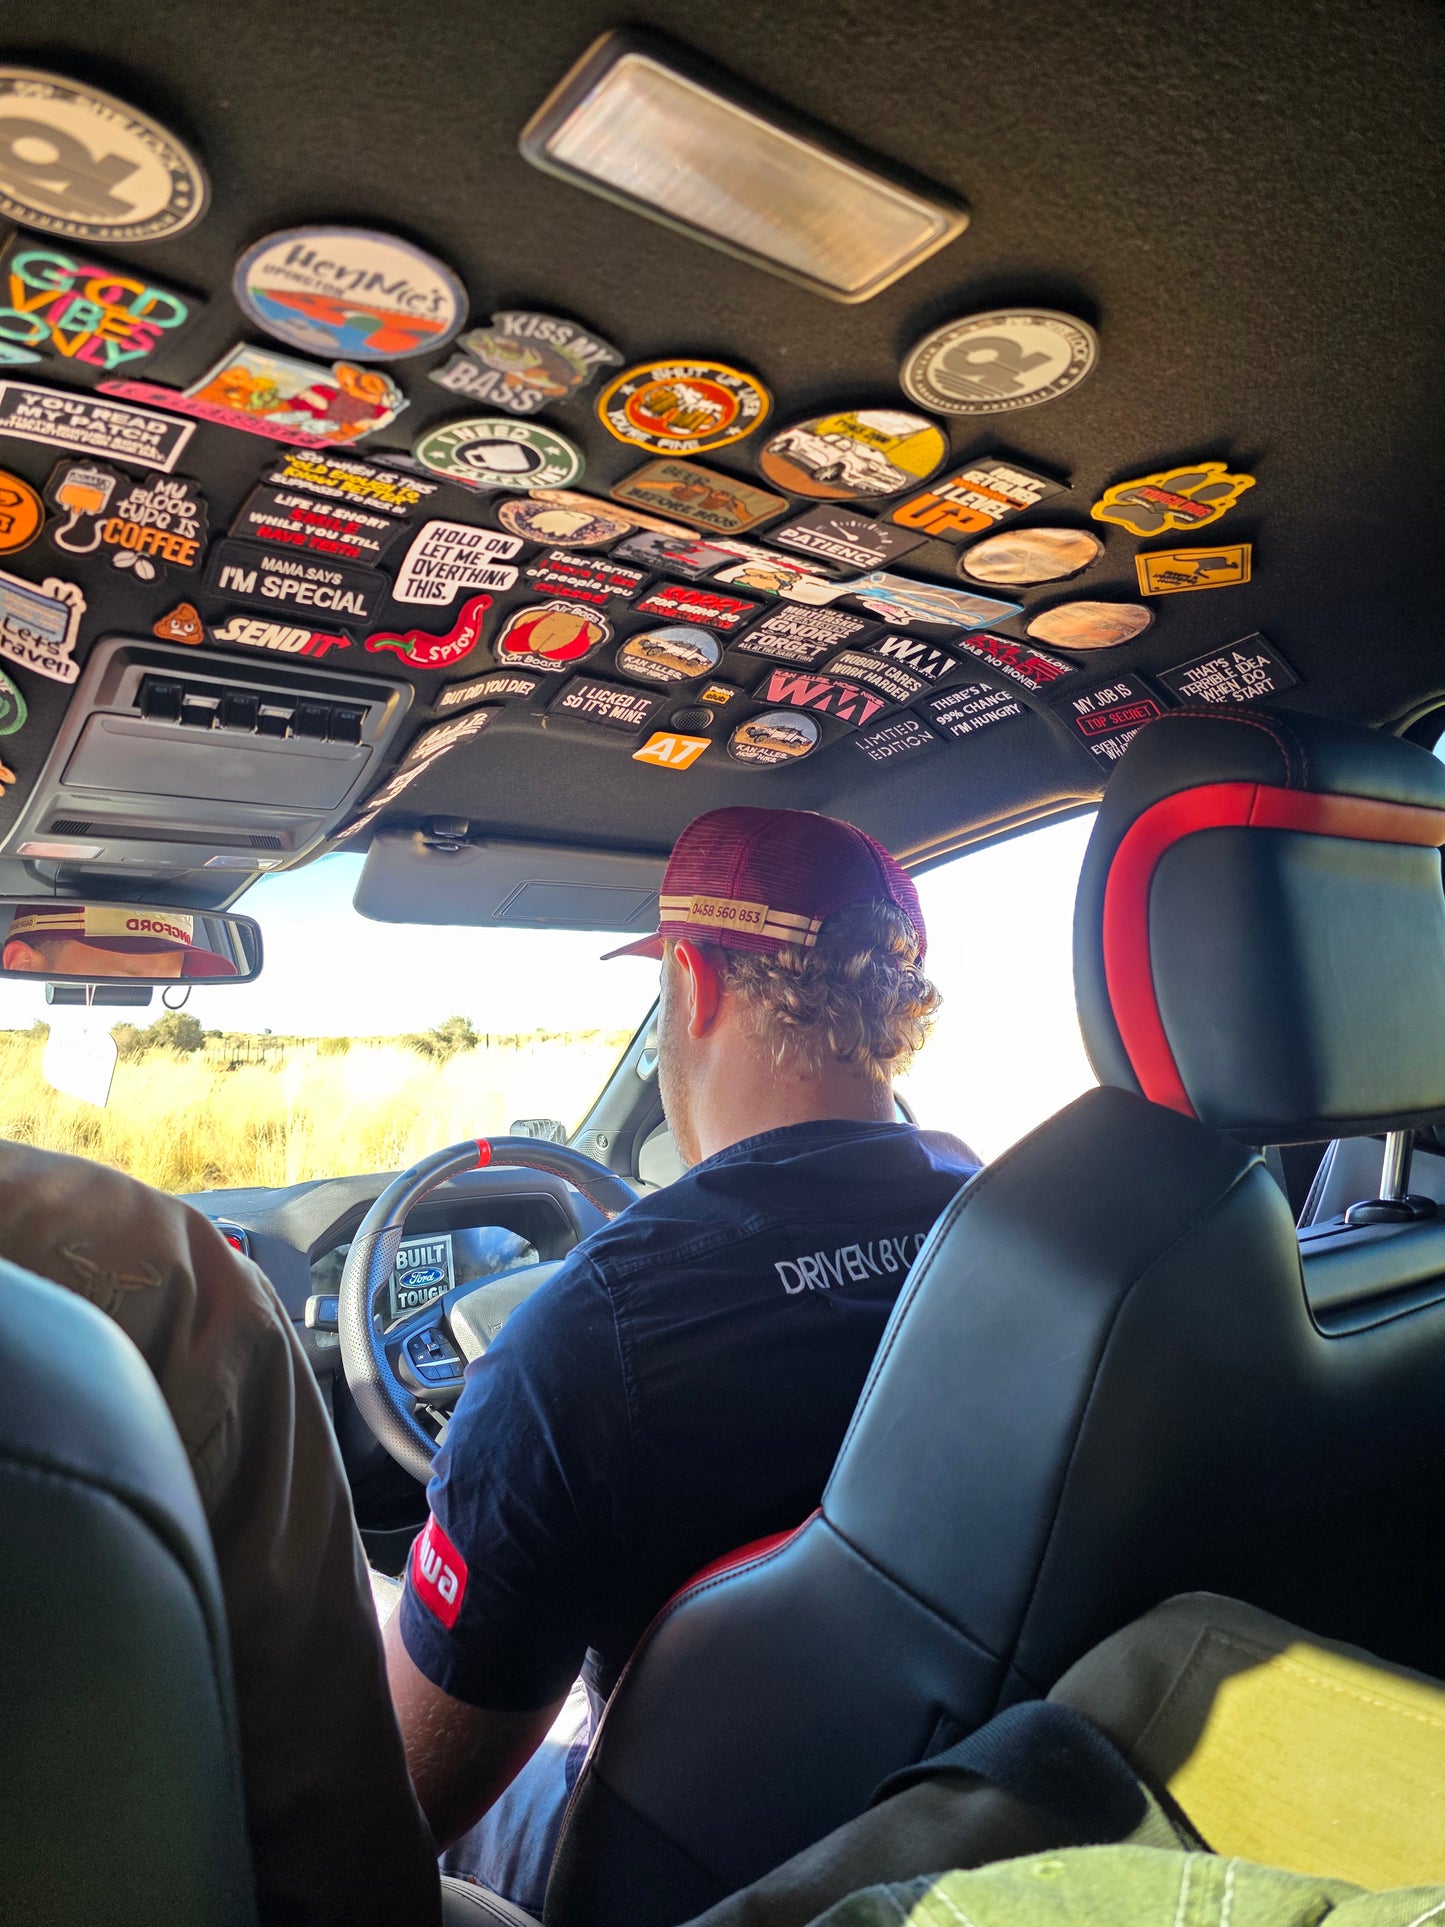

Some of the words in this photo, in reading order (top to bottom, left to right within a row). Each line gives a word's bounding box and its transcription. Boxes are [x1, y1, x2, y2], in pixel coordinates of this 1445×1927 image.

[11, 250, 188, 328] GOOD
[9, 273, 163, 352] VIBES
[504, 315, 573, 344] KISS
[441, 361, 543, 411] BASS
[16, 403, 66, 422] MY
[69, 414, 162, 446] PATCH
[21, 391, 86, 416] YOU
[91, 405, 169, 436] READ
[450, 422, 533, 442] NEED
[154, 478, 188, 498] MY
[269, 472, 344, 498] SUPPOSED
[343, 493, 365, 504] TO
[282, 466, 339, 487] KNOW
[296, 449, 325, 464] SO
[325, 459, 376, 478] WHEN
[375, 472, 399, 484] IS
[396, 478, 438, 496] THIS
[327, 468, 398, 494] ENOUGH
[396, 486, 421, 500] TO
[131, 487, 197, 518] BLOOD
[272, 493, 313, 511] LIFE
[312, 502, 333, 515] IS
[330, 508, 390, 530] SHORT
[627, 488, 695, 514] BEFORE
[691, 511, 738, 528] BROS
[892, 492, 994, 537] UP
[929, 482, 956, 496] I
[944, 487, 1013, 520] LEVEL
[116, 499, 171, 529] type
[173, 517, 200, 539] IS
[249, 511, 303, 532] WHILE
[302, 523, 340, 539] YOU
[338, 533, 381, 551] STILL
[288, 507, 361, 535] SMILE
[103, 517, 200, 567] COFFEE
[255, 525, 307, 547] HAVE
[307, 536, 361, 558] TEETH
[419, 541, 455, 560] LET
[452, 548, 486, 566] ME
[429, 527, 483, 547] HOLD
[484, 538, 516, 555] ON
[779, 528, 884, 567] PATIENCE
[261, 556, 304, 576] MAMA
[303, 567, 344, 586] SAYS
[410, 558, 512, 587] OVERTHINK
[549, 550, 591, 568] Dear
[590, 560, 643, 581] Karma
[549, 562, 592, 579] have
[218, 565, 258, 594] I'M
[260, 575, 369, 617] SPECIAL
[404, 577, 446, 600] THIS.
[526, 567, 550, 577] of
[545, 570, 602, 590] people
[600, 582, 634, 597] you
[532, 582, 609, 605] missed
[549, 603, 572, 613] Air
[646, 595, 680, 608] FOR
[717, 611, 742, 623] SO
[656, 586, 756, 614] SORRY
[760, 618, 848, 645] IGNORE
[782, 605, 865, 632] MULTITASKER
[2, 616, 60, 656] Lets
[742, 631, 828, 657] FORGET
[0, 632, 71, 677] ravel!
[506, 653, 522, 662] On
[524, 655, 562, 669] Board
[623, 655, 648, 669] KAN
[1026, 648, 1073, 673] FOLLOW
[1183, 656, 1230, 682] THAT'S
[1231, 651, 1247, 664] A
[829, 662, 867, 680] WORK
[863, 671, 911, 702] HARDER
[840, 652, 890, 672] NOBODY
[884, 665, 922, 693] CARES
[983, 653, 1003, 668] NO
[1001, 665, 1043, 692] MONEY
[1178, 668, 1238, 698] TERRIBLE
[1233, 654, 1272, 678] IDEA
[1198, 681, 1239, 702] WHEN
[1240, 668, 1266, 686] DO
[440, 690, 465, 706] BUT
[464, 682, 486, 700] DID
[484, 678, 508, 695] YOU
[505, 679, 536, 696] DIE?
[577, 684, 589, 697] I
[585, 686, 635, 708] LICKED
[632, 698, 652, 711] IT
[705, 692, 727, 702] club
[930, 685, 981, 712] THERE'S
[979, 682, 993, 693] A
[1072, 697, 1097, 716] MY
[1093, 689, 1120, 707] JOB
[1114, 683, 1133, 699] IS
[1231, 677, 1276, 703] START
[562, 694, 584, 709] SO
[581, 698, 611, 716] IT'S
[608, 705, 647, 725] MINE
[935, 708, 965, 726] 99%
[962, 690, 1014, 715] CHANCE
[949, 724, 973, 737] I'M
[969, 702, 1022, 731] HUNGRY
[1085, 712, 1109, 732] TOP
[1108, 705, 1153, 725] SECRET
[735, 744, 758, 754] KAN
[854, 720, 920, 751] LIMITED
[867, 730, 935, 761] EDITION
[1090, 737, 1120, 756] EVEN
[691, 902, 714, 916] 0458
[716, 905, 737, 921] 560
[738, 908, 762, 924] 853
[396, 1244, 445, 1270] BUILT
[774, 1243, 884, 1294] DRIVEN
[409, 1270, 435, 1285] Ford
